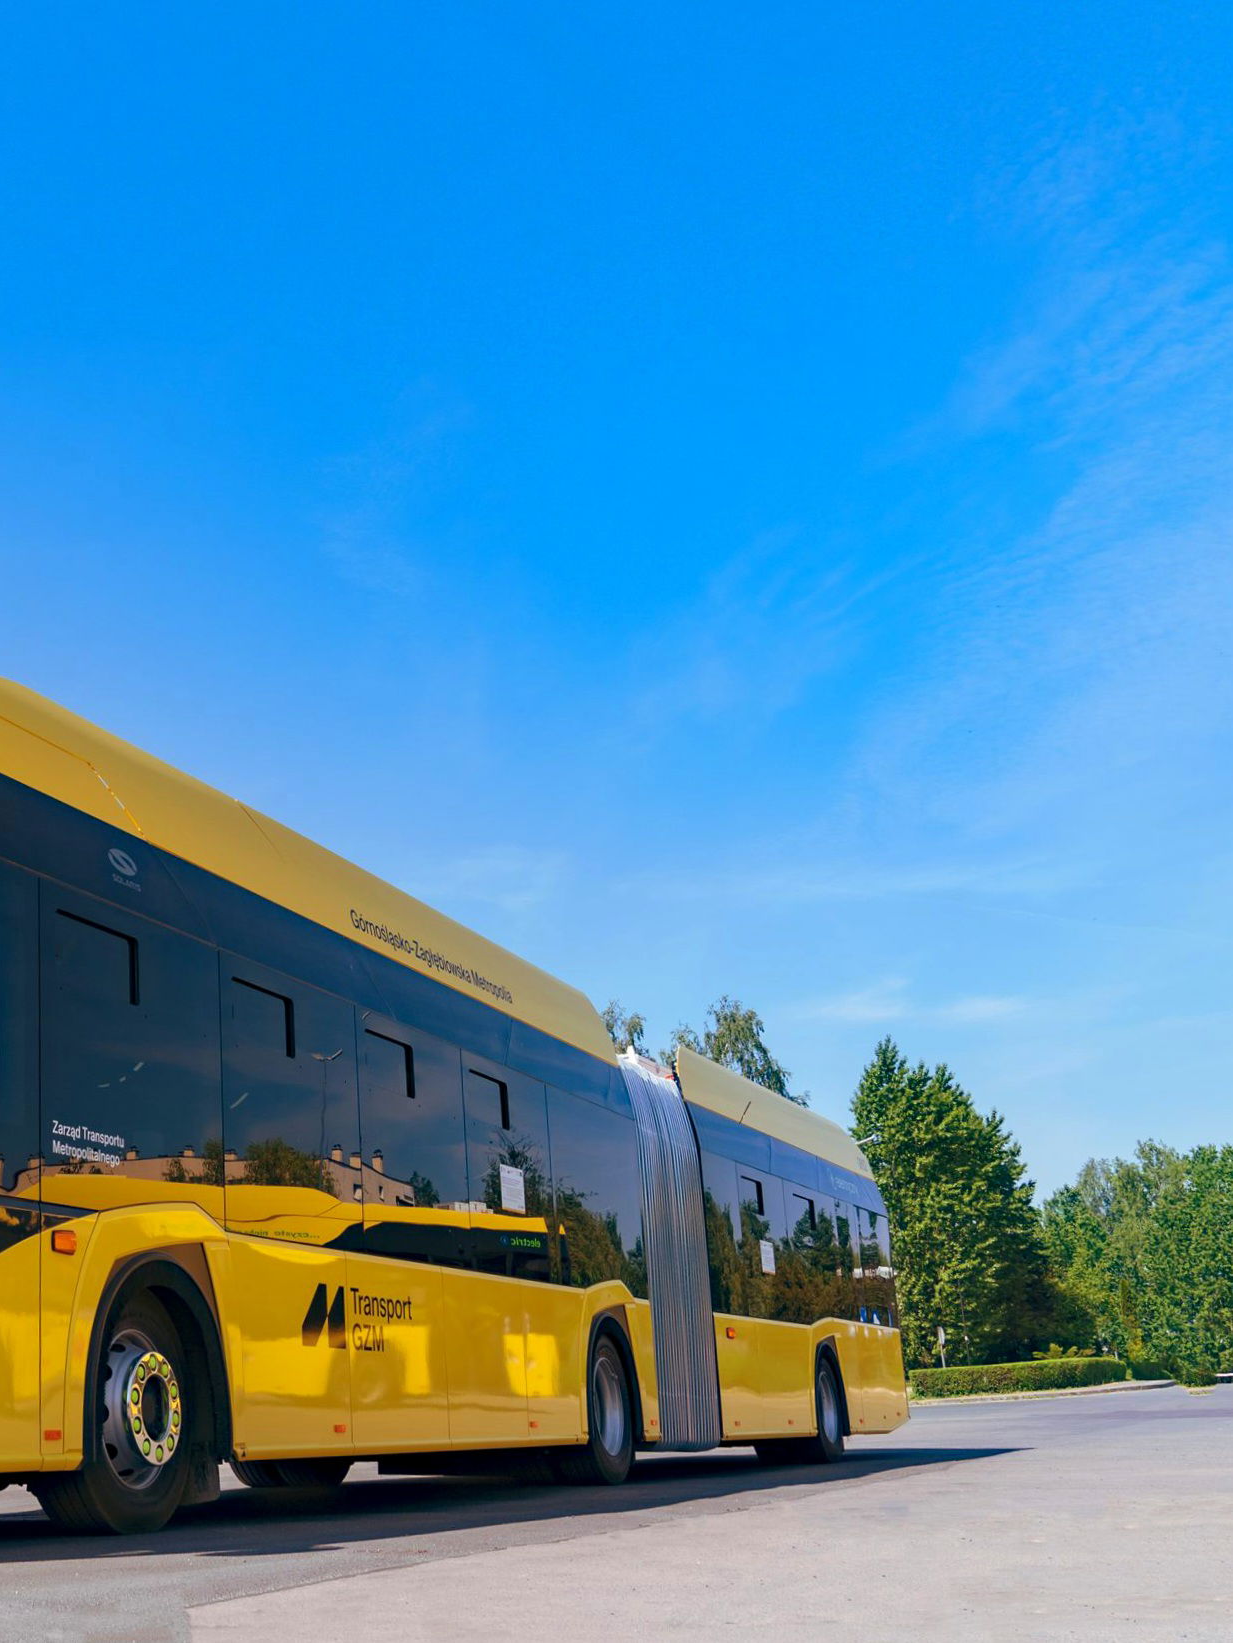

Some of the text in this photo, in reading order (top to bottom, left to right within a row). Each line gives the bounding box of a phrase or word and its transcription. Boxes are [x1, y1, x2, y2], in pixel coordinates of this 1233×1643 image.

[349, 908, 514, 1003] Górnośląsko-Zagłębiowska Metropolia
[52, 1120, 125, 1148] Zarząd Transportu
[52, 1140, 120, 1167] Metropolitalnego
[350, 1287, 412, 1324] Transport
[352, 1323, 385, 1352] GZM
